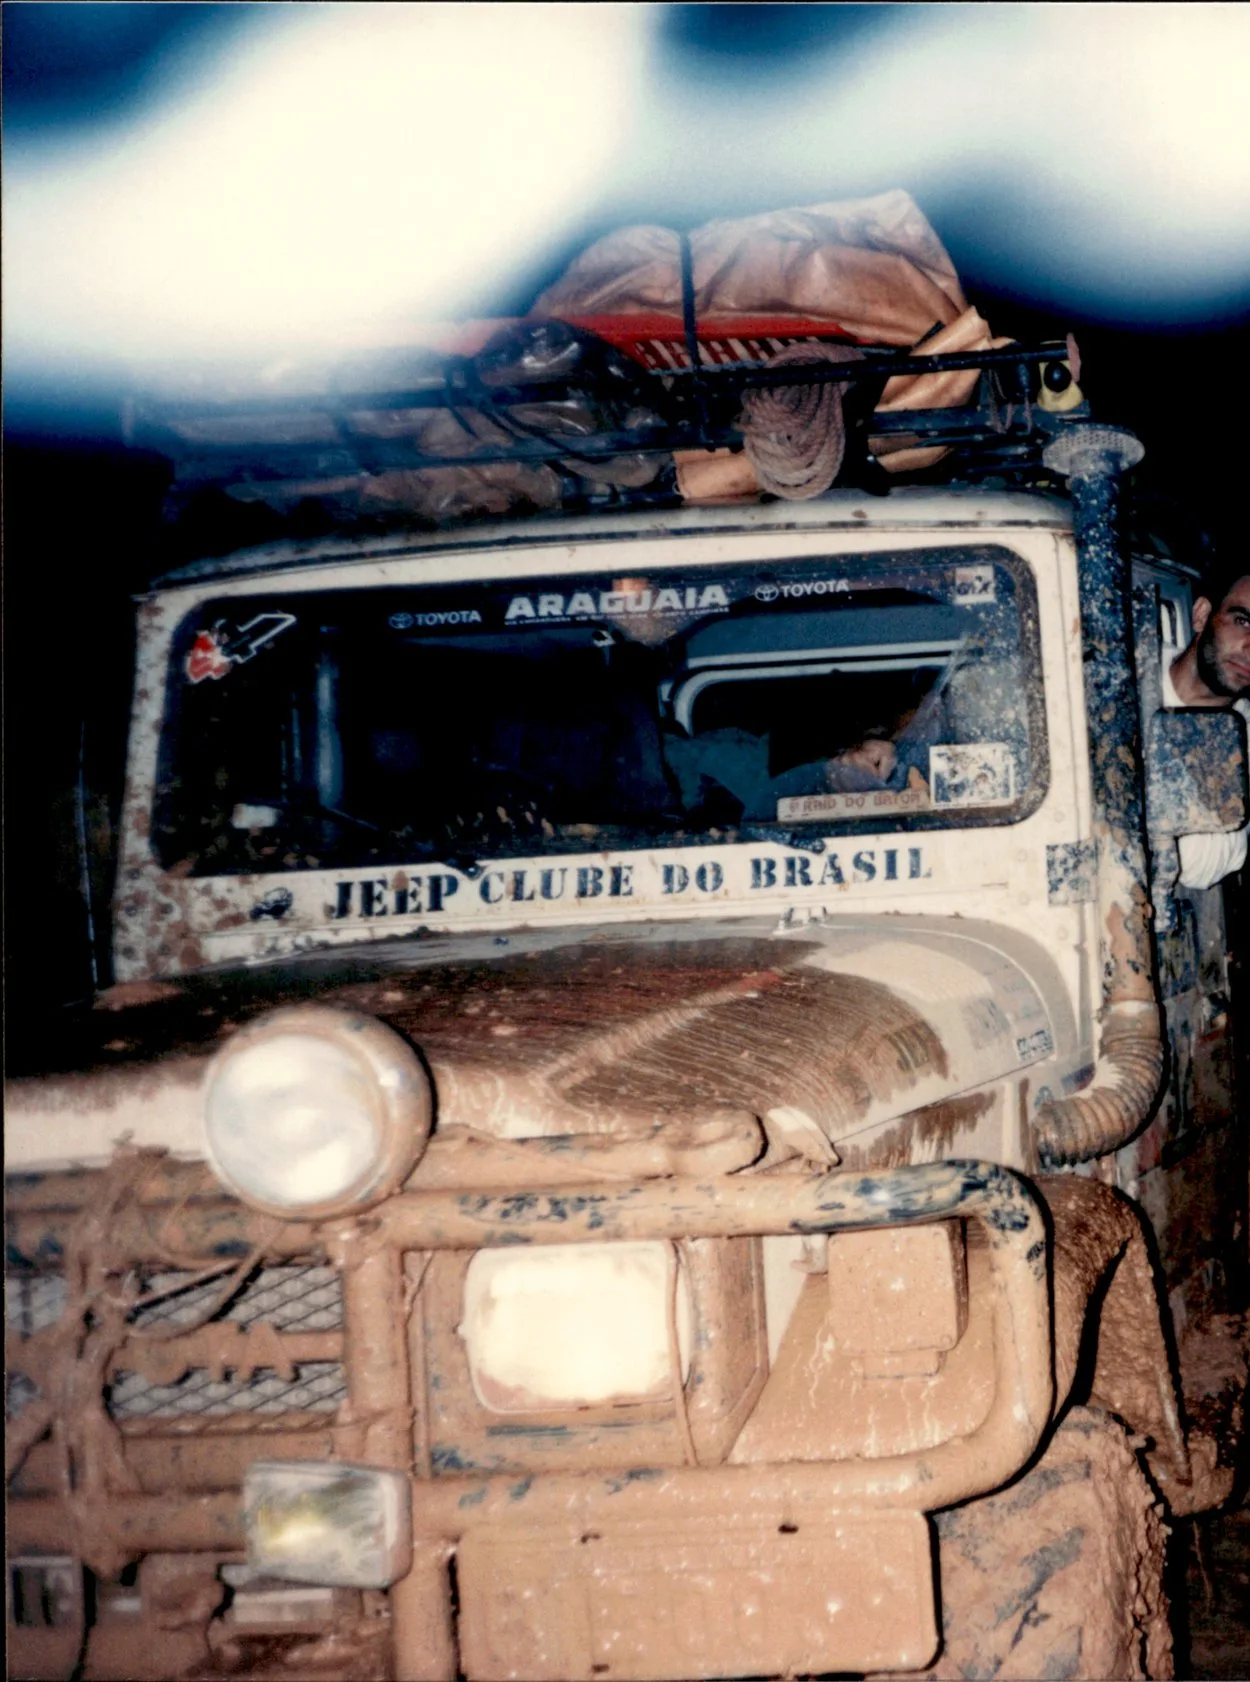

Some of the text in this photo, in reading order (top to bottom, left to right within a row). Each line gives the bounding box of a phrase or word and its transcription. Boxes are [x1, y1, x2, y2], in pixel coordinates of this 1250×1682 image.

[781, 578, 849, 598] TOYOTA
[504, 584, 730, 620] ARAGUAIA
[415, 610, 482, 626] TOYOTA
[803, 797, 837, 812] RAID
[845, 795, 866, 810] DO
[328, 847, 932, 919] JEEP CLUBE DO BRASIL
